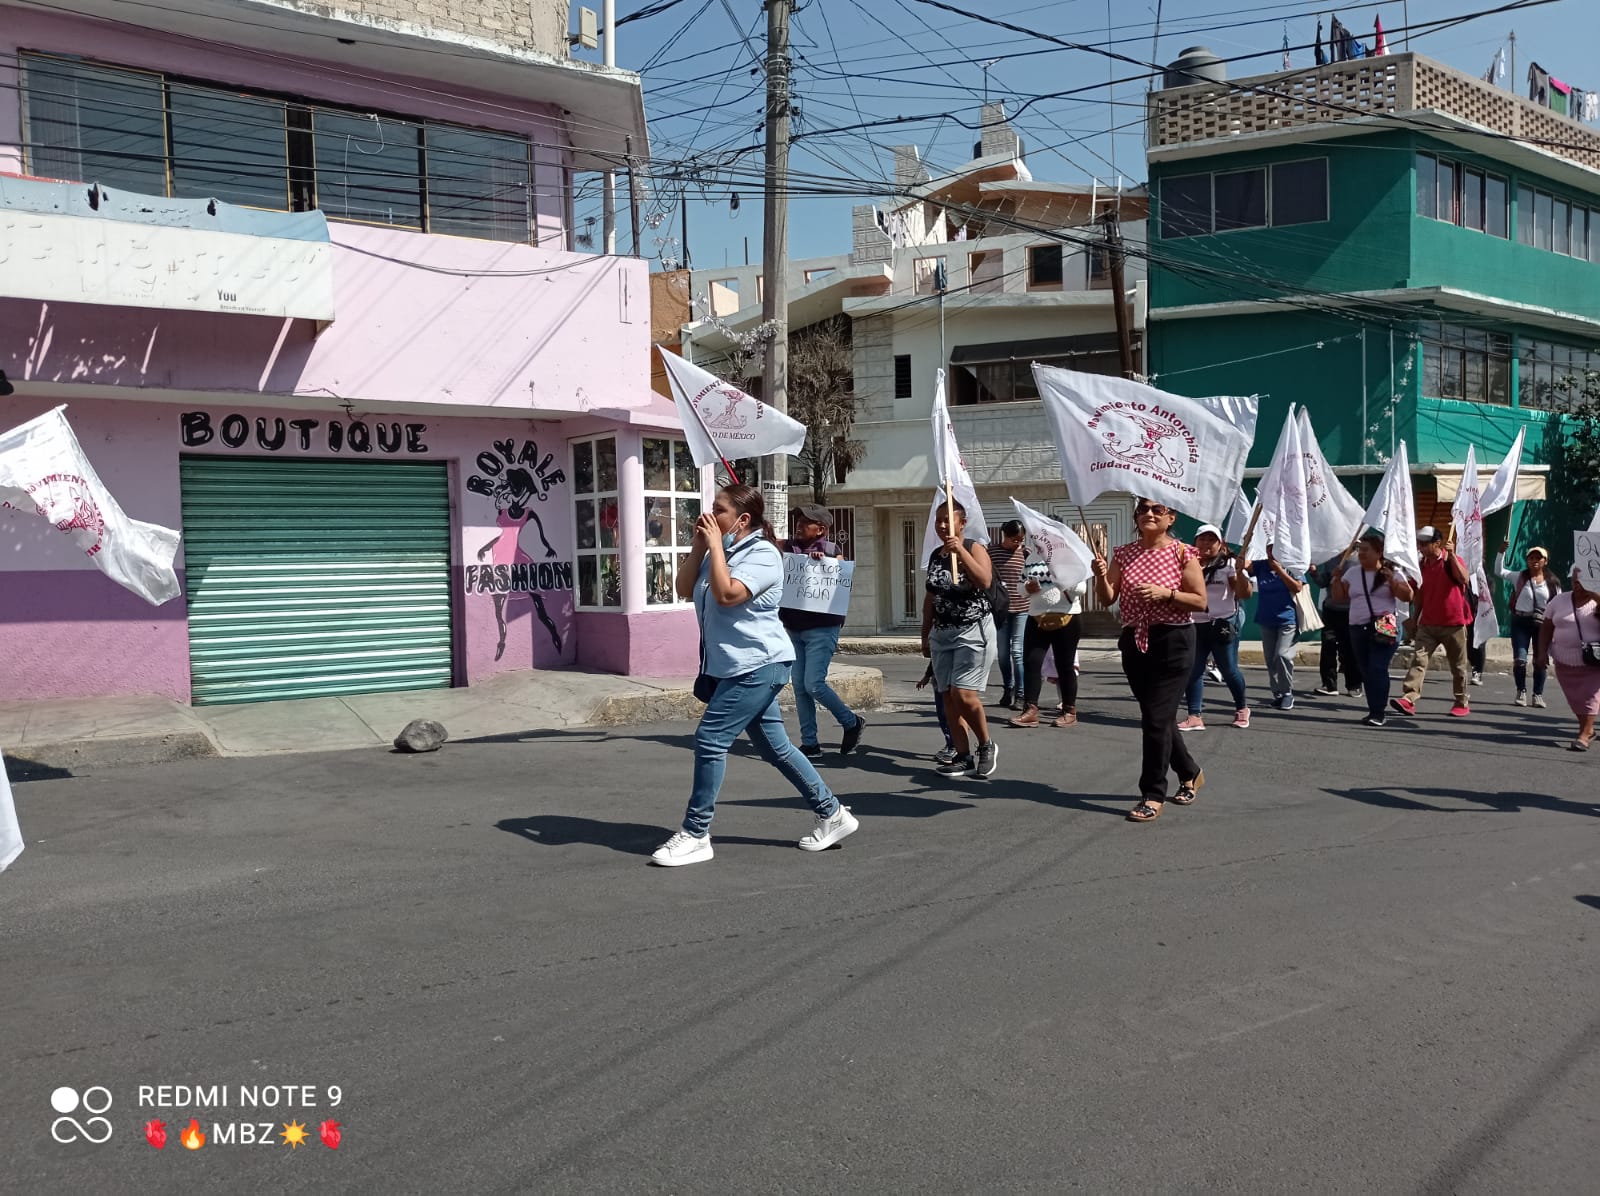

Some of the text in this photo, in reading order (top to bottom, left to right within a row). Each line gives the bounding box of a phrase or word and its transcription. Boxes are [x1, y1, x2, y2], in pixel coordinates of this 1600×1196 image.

[180, 411, 429, 454] BOUTIQUE
[1087, 400, 1200, 464] Movimiento Antorchista
[466, 438, 567, 497] ROYALE
[1090, 460, 1131, 472] Ciudad
[1133, 467, 1149, 476] de
[465, 561, 574, 594] FASHION
[784, 557, 843, 575] DIRECTOR
[796, 585, 830, 601] AGUA
